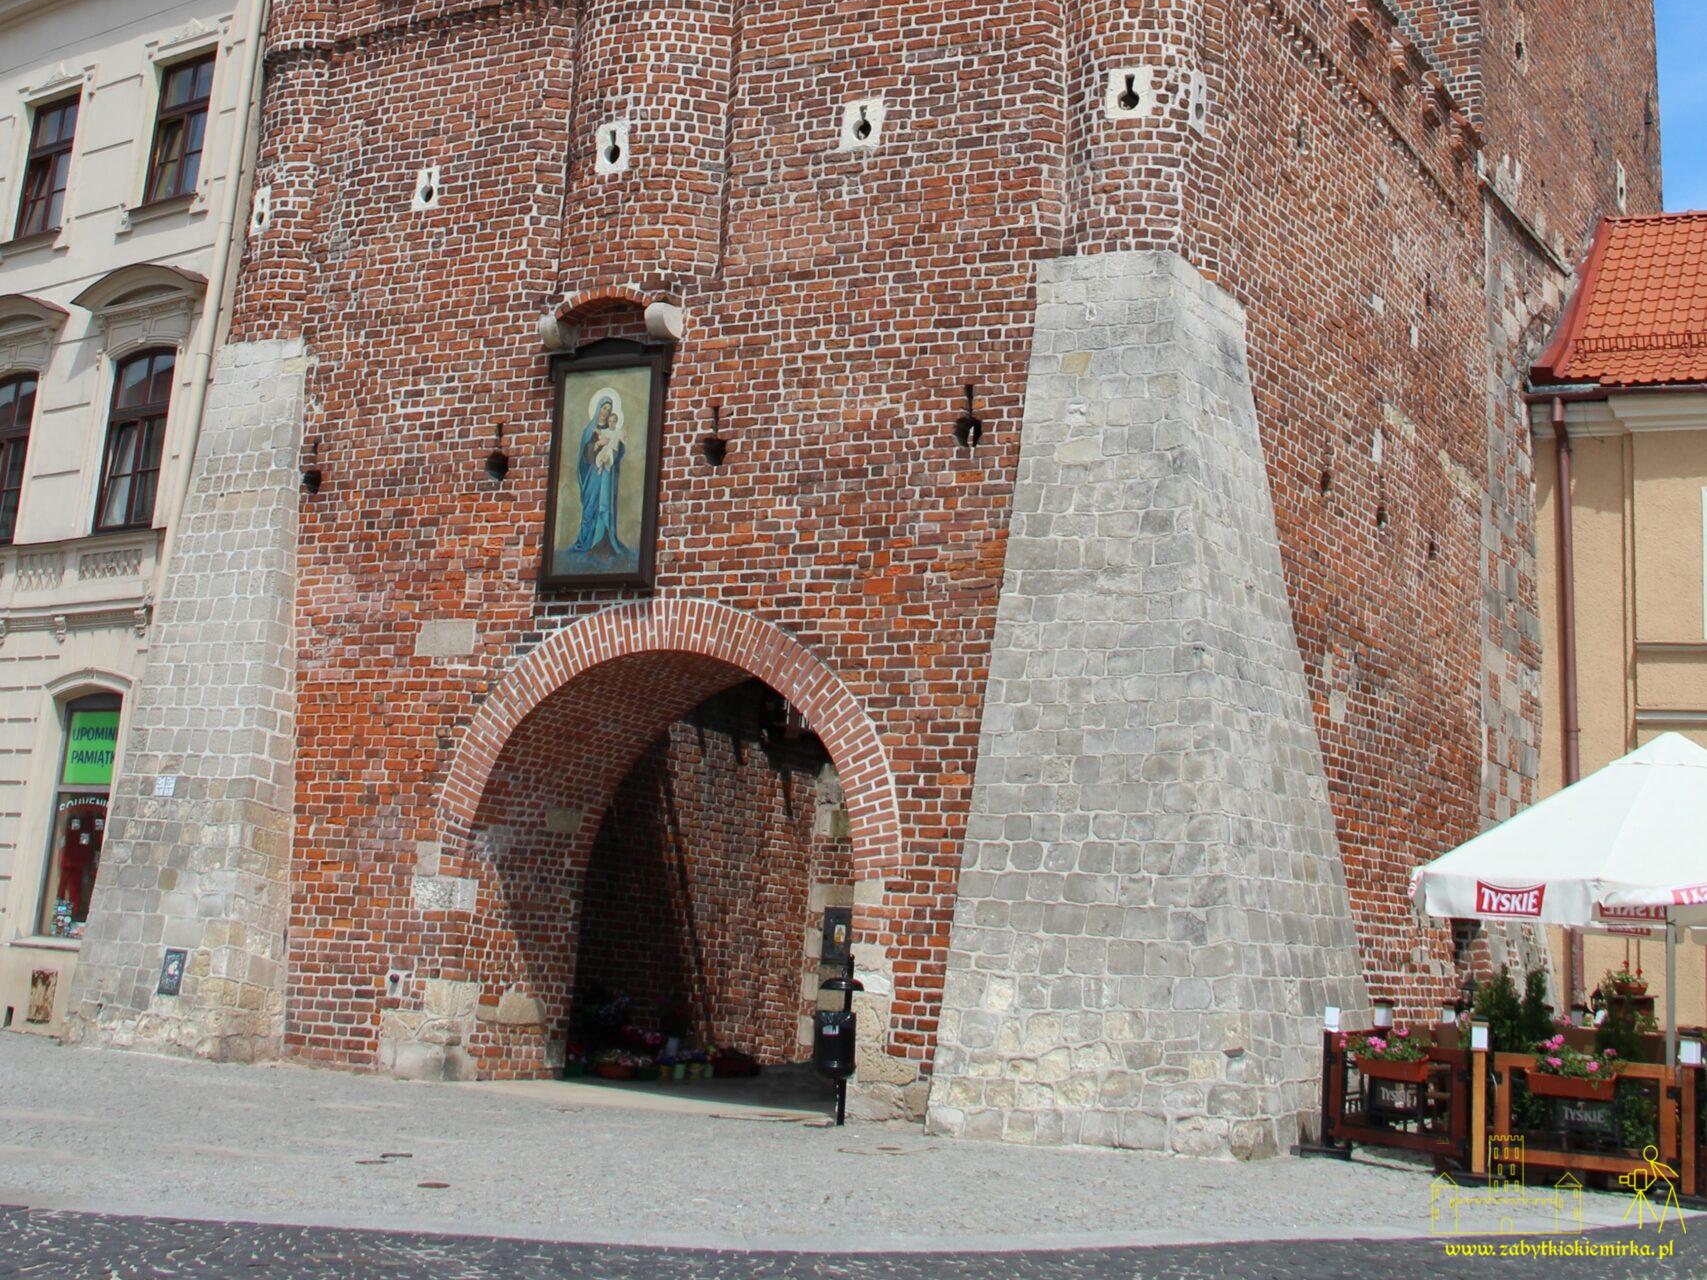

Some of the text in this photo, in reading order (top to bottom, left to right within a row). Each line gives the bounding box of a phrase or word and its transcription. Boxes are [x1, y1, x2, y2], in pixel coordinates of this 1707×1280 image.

[72, 727, 118, 741] UPOMIN
[59, 797, 109, 811] SOUVENI
[1481, 887, 1540, 913] TYSKIE
[1563, 1106, 1605, 1122] TYSKIE
